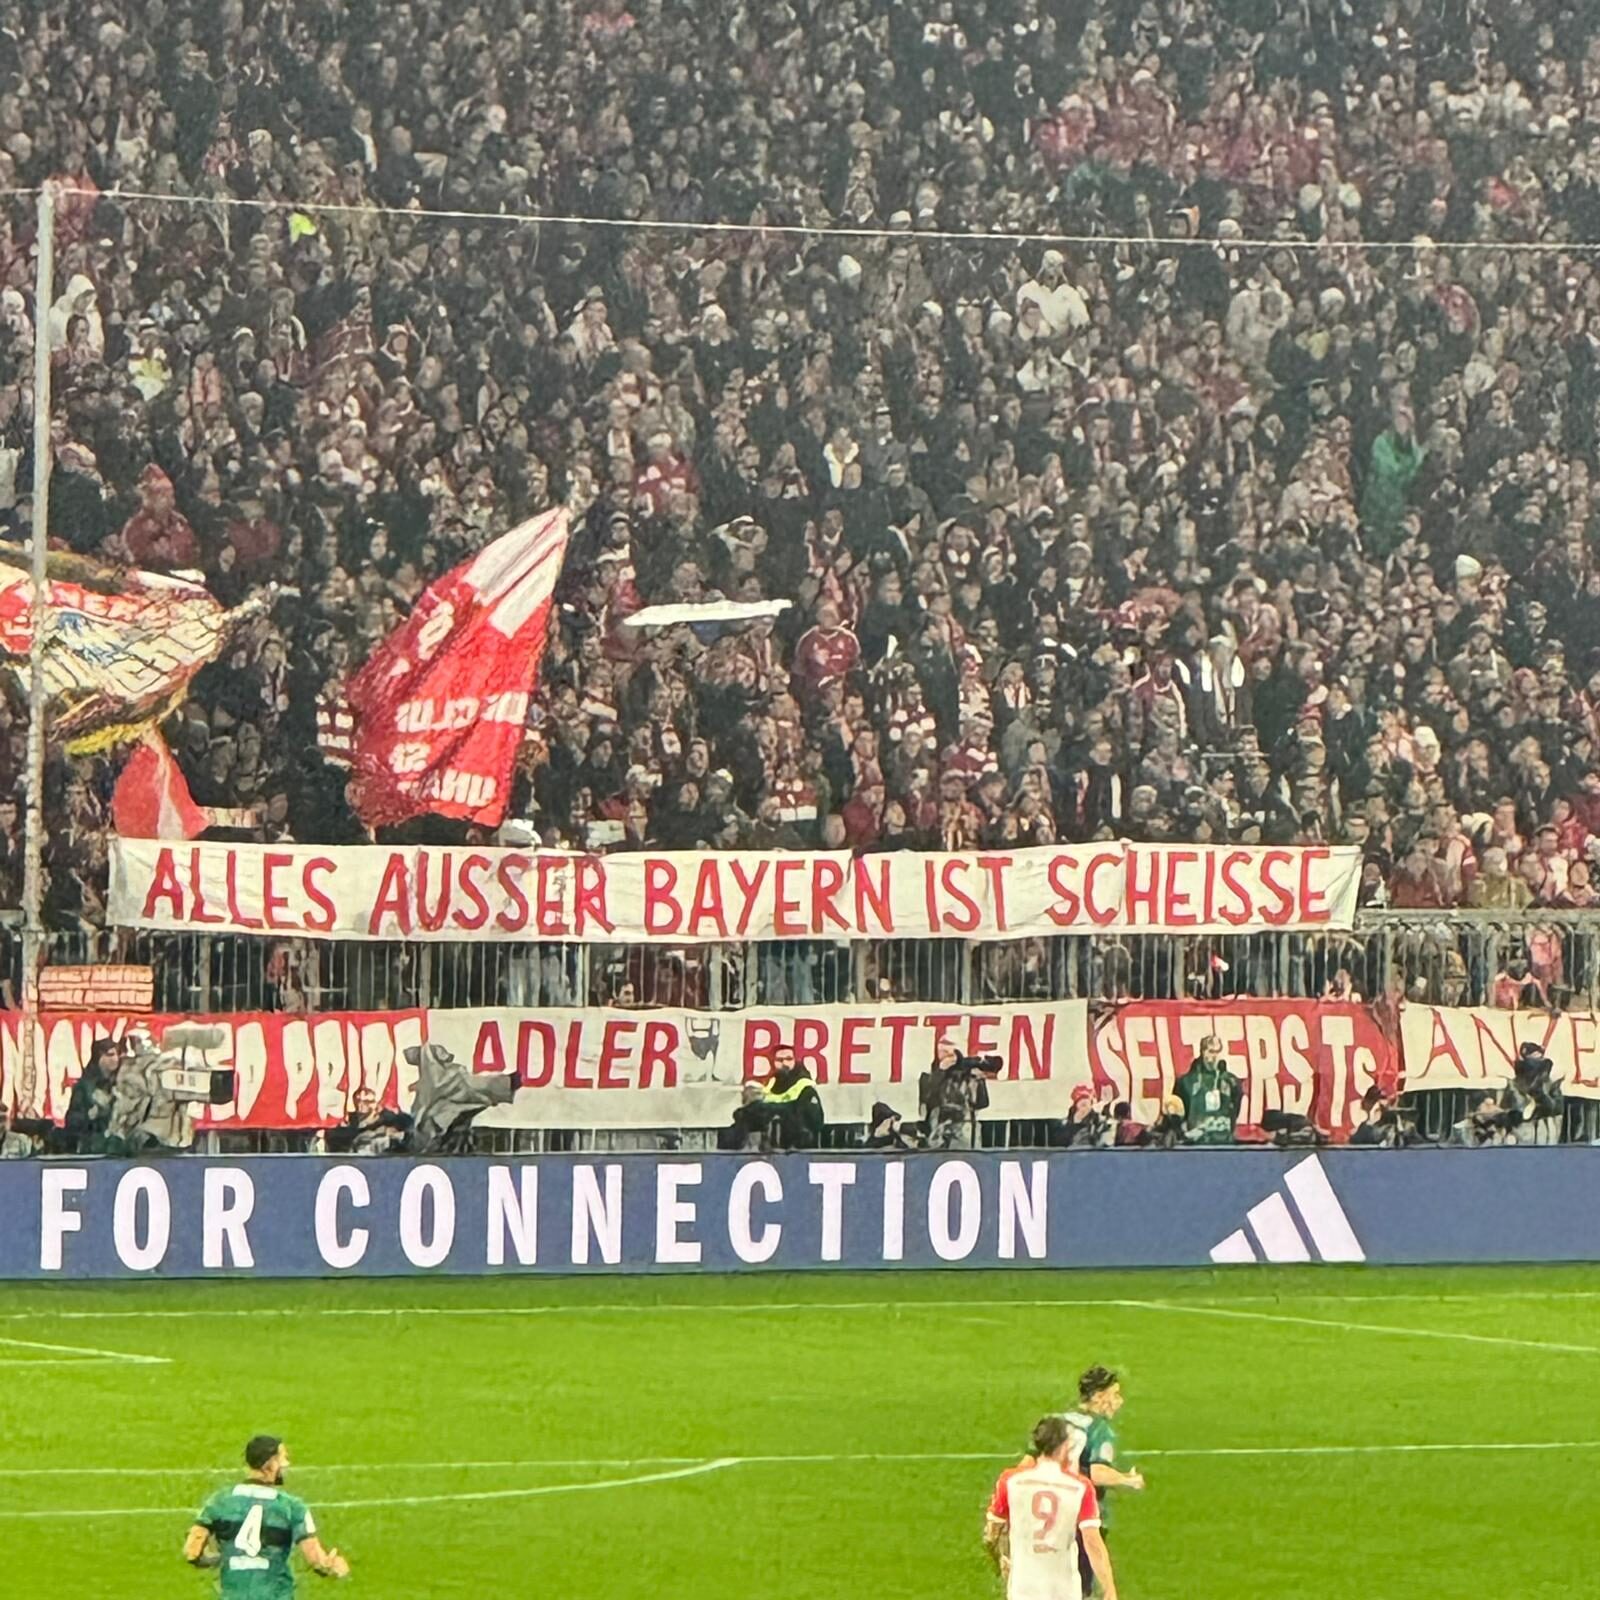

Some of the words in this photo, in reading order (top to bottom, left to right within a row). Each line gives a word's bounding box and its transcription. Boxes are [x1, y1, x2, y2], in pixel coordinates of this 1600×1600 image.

[142, 847, 338, 932] ALLES
[369, 851, 616, 936] AUSSER
[643, 856, 895, 937] BAYERN
[924, 856, 1013, 932] IST
[1044, 849, 1331, 926] SCHEISSE
[472, 1020, 680, 1090] ADLER
[742, 1013, 1056, 1089] BRETTEN
[40, 1166, 255, 1271] FOR
[314, 1161, 1049, 1269] CONNECTION
[234, 1504, 263, 1557] 4
[1031, 1490, 1059, 1541] 9
